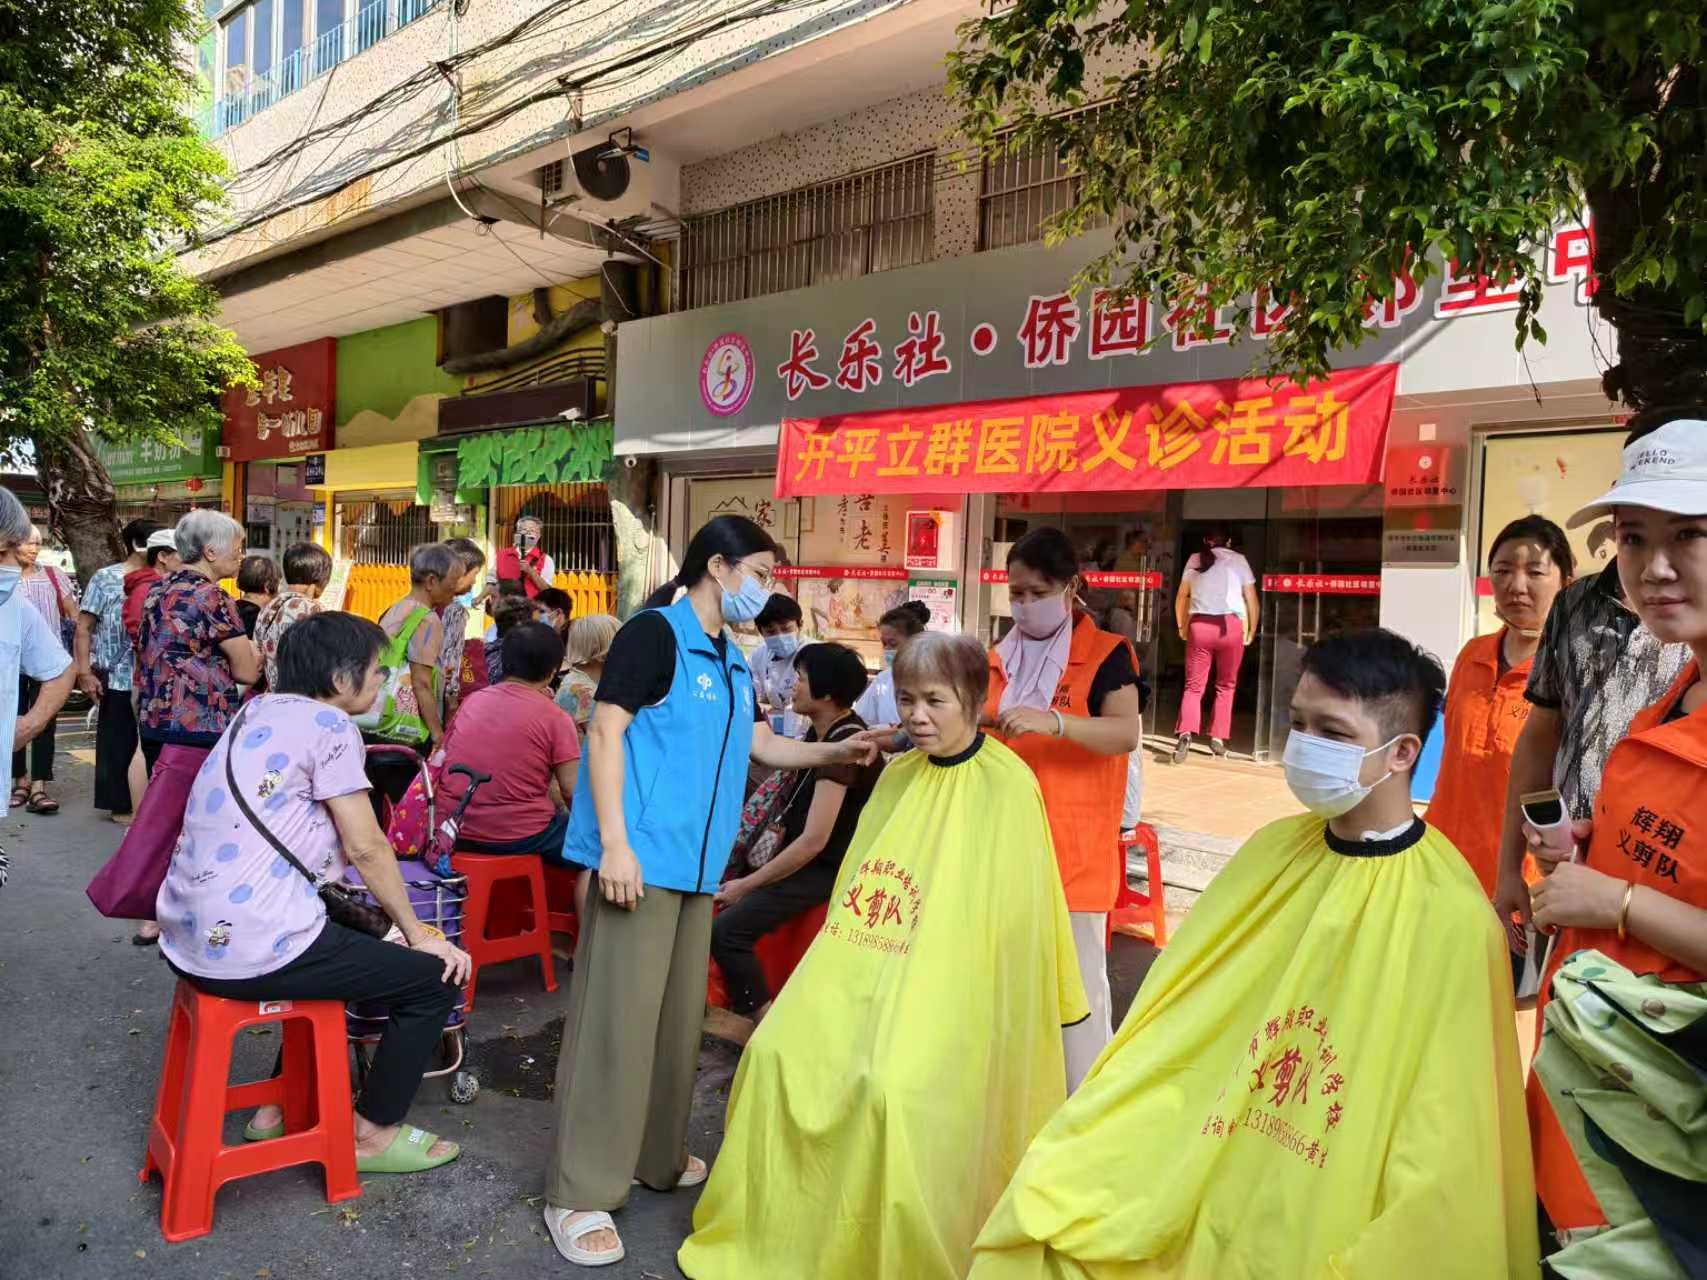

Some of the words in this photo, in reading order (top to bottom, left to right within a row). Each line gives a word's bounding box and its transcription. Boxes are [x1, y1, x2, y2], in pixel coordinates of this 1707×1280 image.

[794, 391, 1350, 482] 开平立群医院义诊活动
[1630, 806, 1685, 850] 辉翔
[1616, 829, 1679, 884] 义剪队
[842, 883, 903, 929] 义剪队
